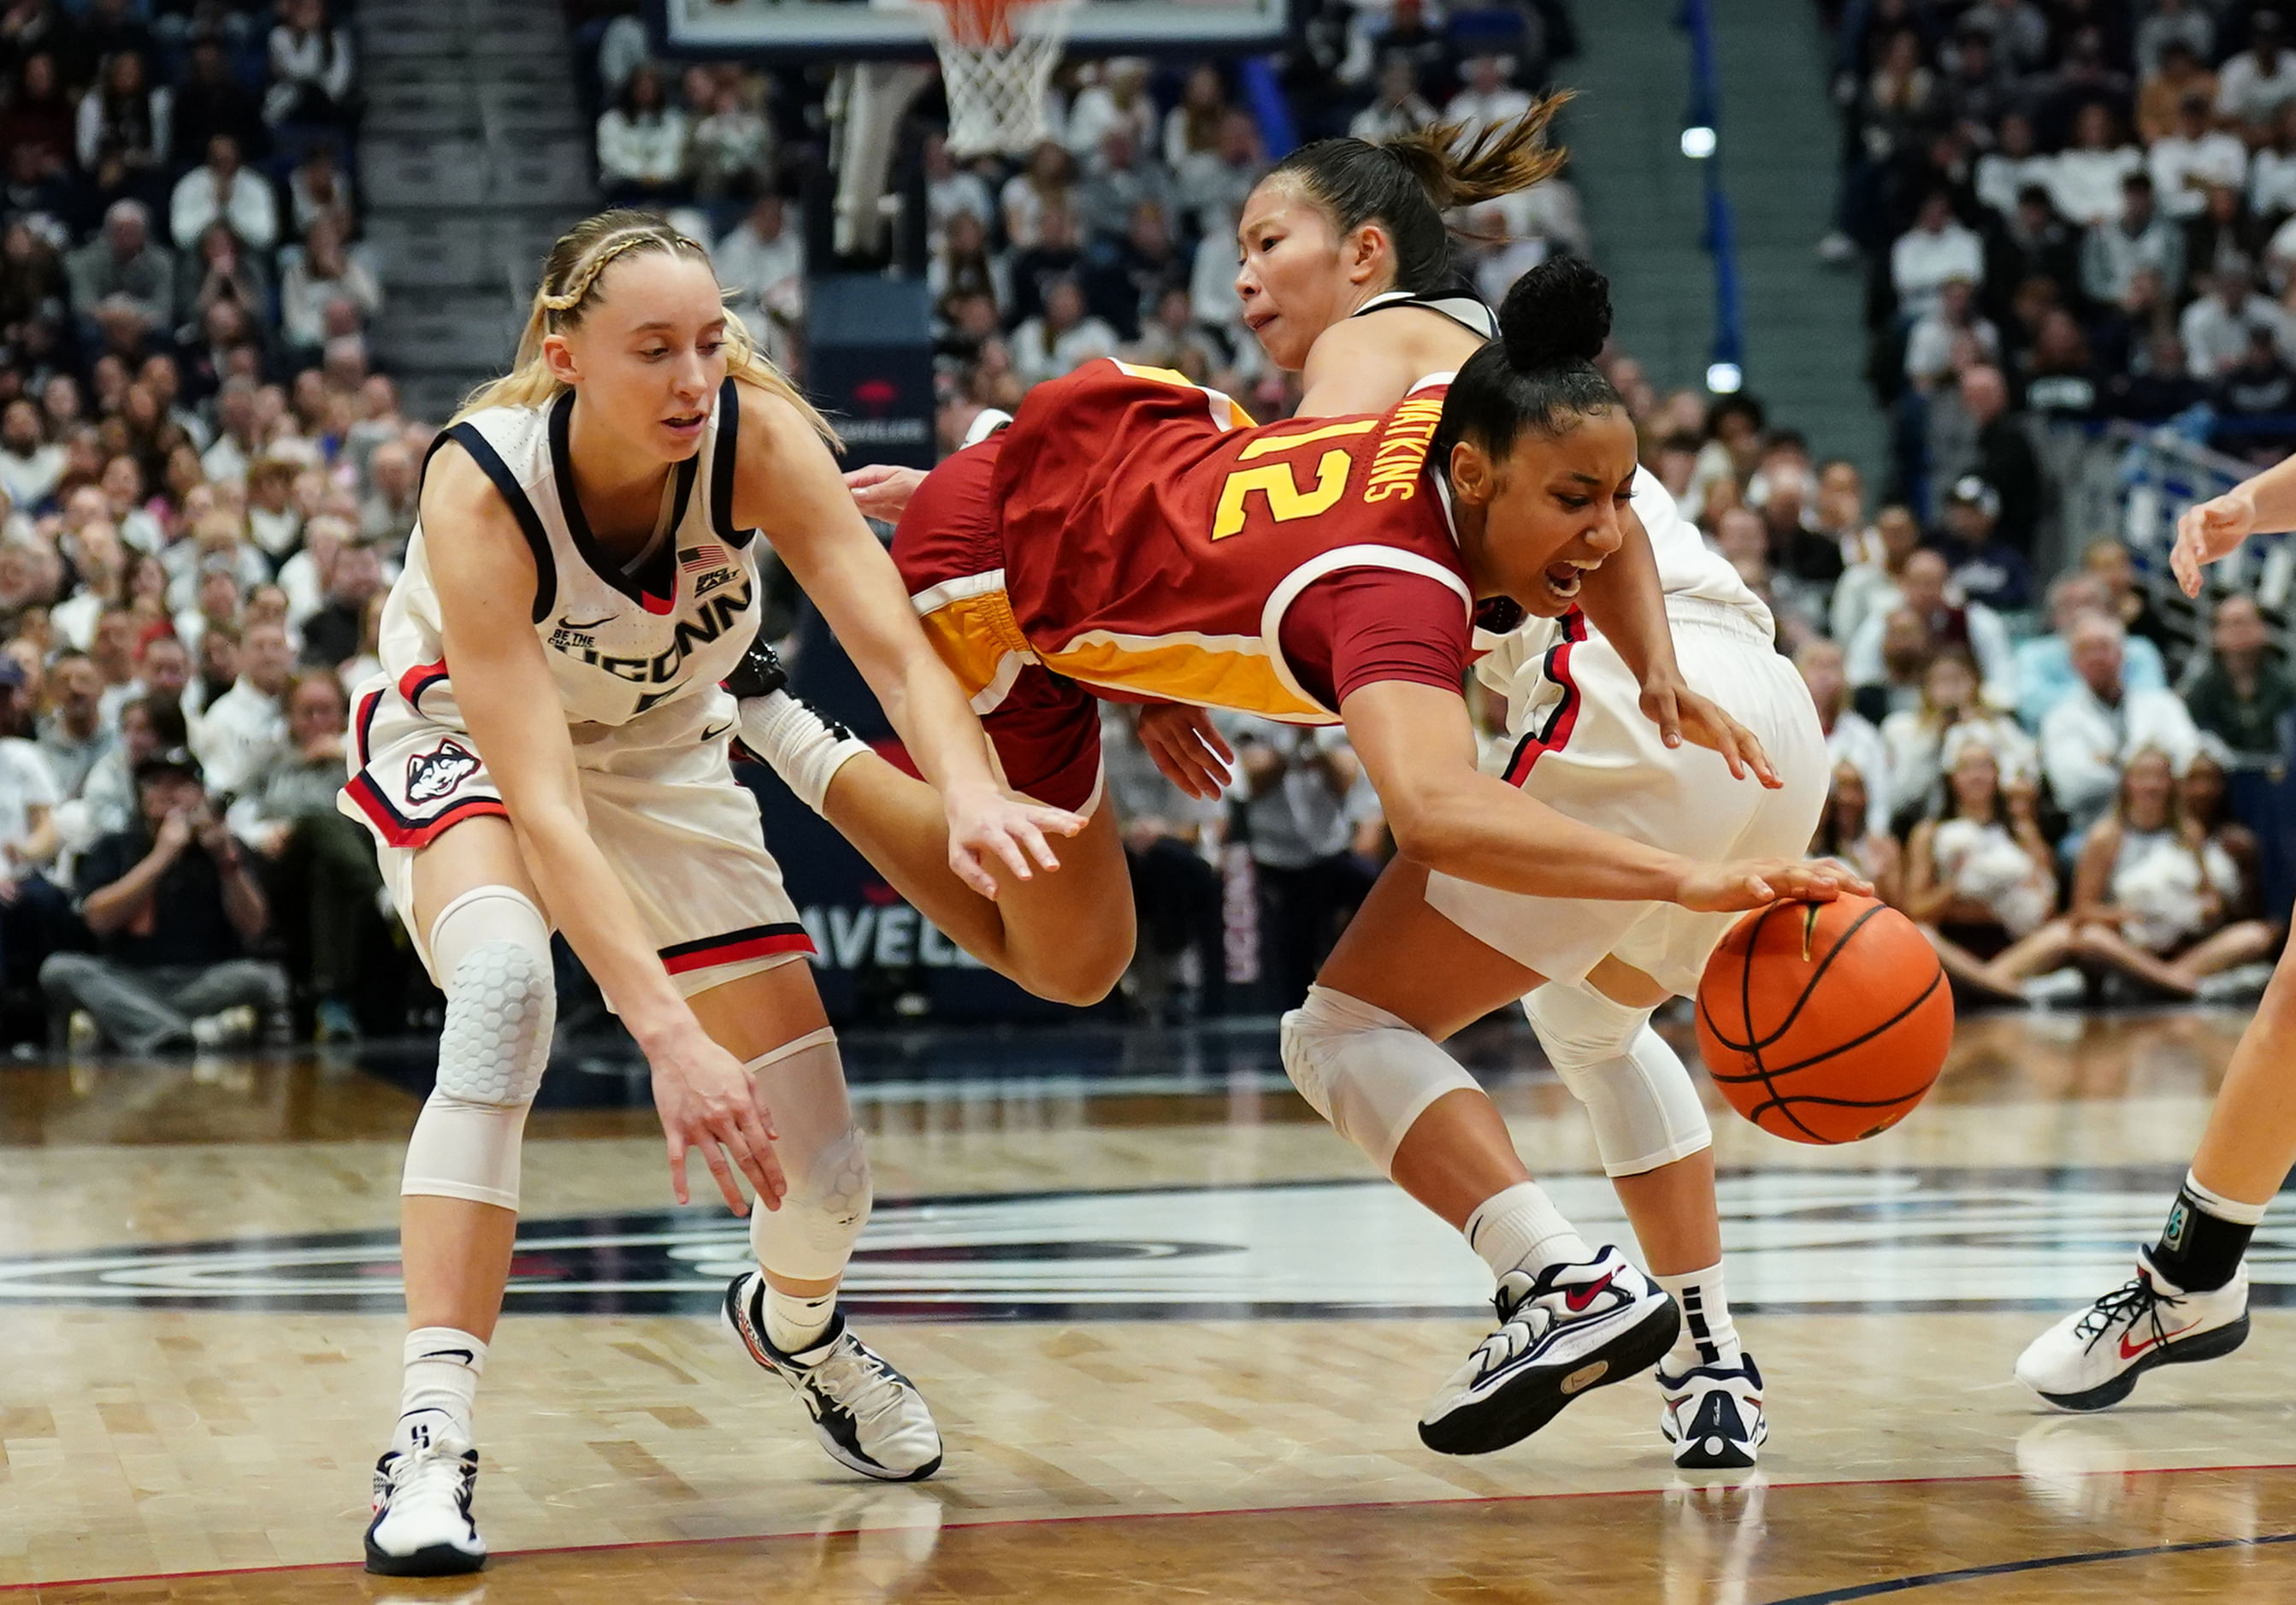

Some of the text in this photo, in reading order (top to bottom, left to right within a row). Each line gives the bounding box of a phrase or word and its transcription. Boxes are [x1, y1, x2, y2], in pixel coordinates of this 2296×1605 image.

[1210, 419, 1379, 542] 12
[1363, 398, 1443, 503] WATKINS
[553, 628, 596, 646] BE THE
